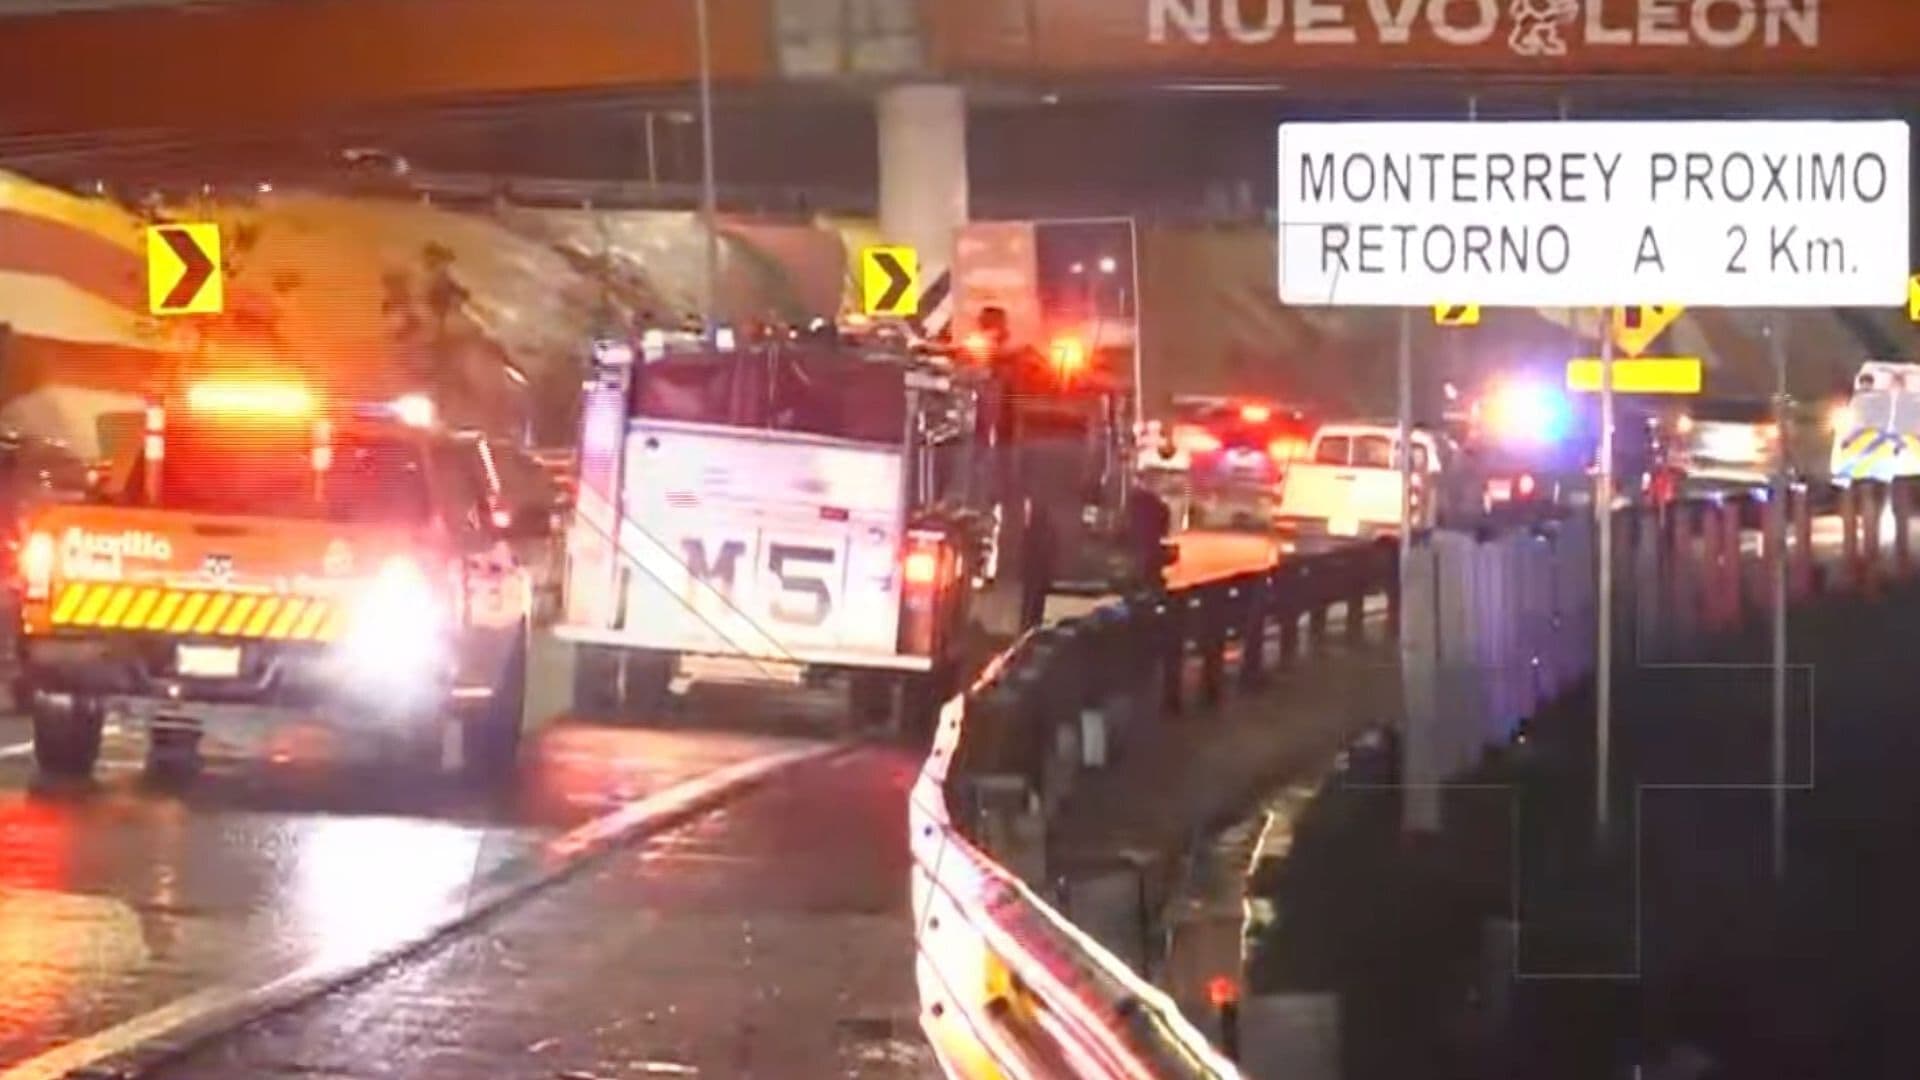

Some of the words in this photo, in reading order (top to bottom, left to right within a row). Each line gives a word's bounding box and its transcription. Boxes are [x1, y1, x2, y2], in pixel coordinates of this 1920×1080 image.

[1148, 0, 1498, 46] NUEVO
[1301, 152, 1622, 203] MONTERREY
[1650, 152, 1888, 203] PROXIMO
[1321, 225, 1570, 274] RETORNO
[1634, 226, 1664, 272] A
[1726, 225, 1748, 273] 2
[681, 537, 836, 626] M5
